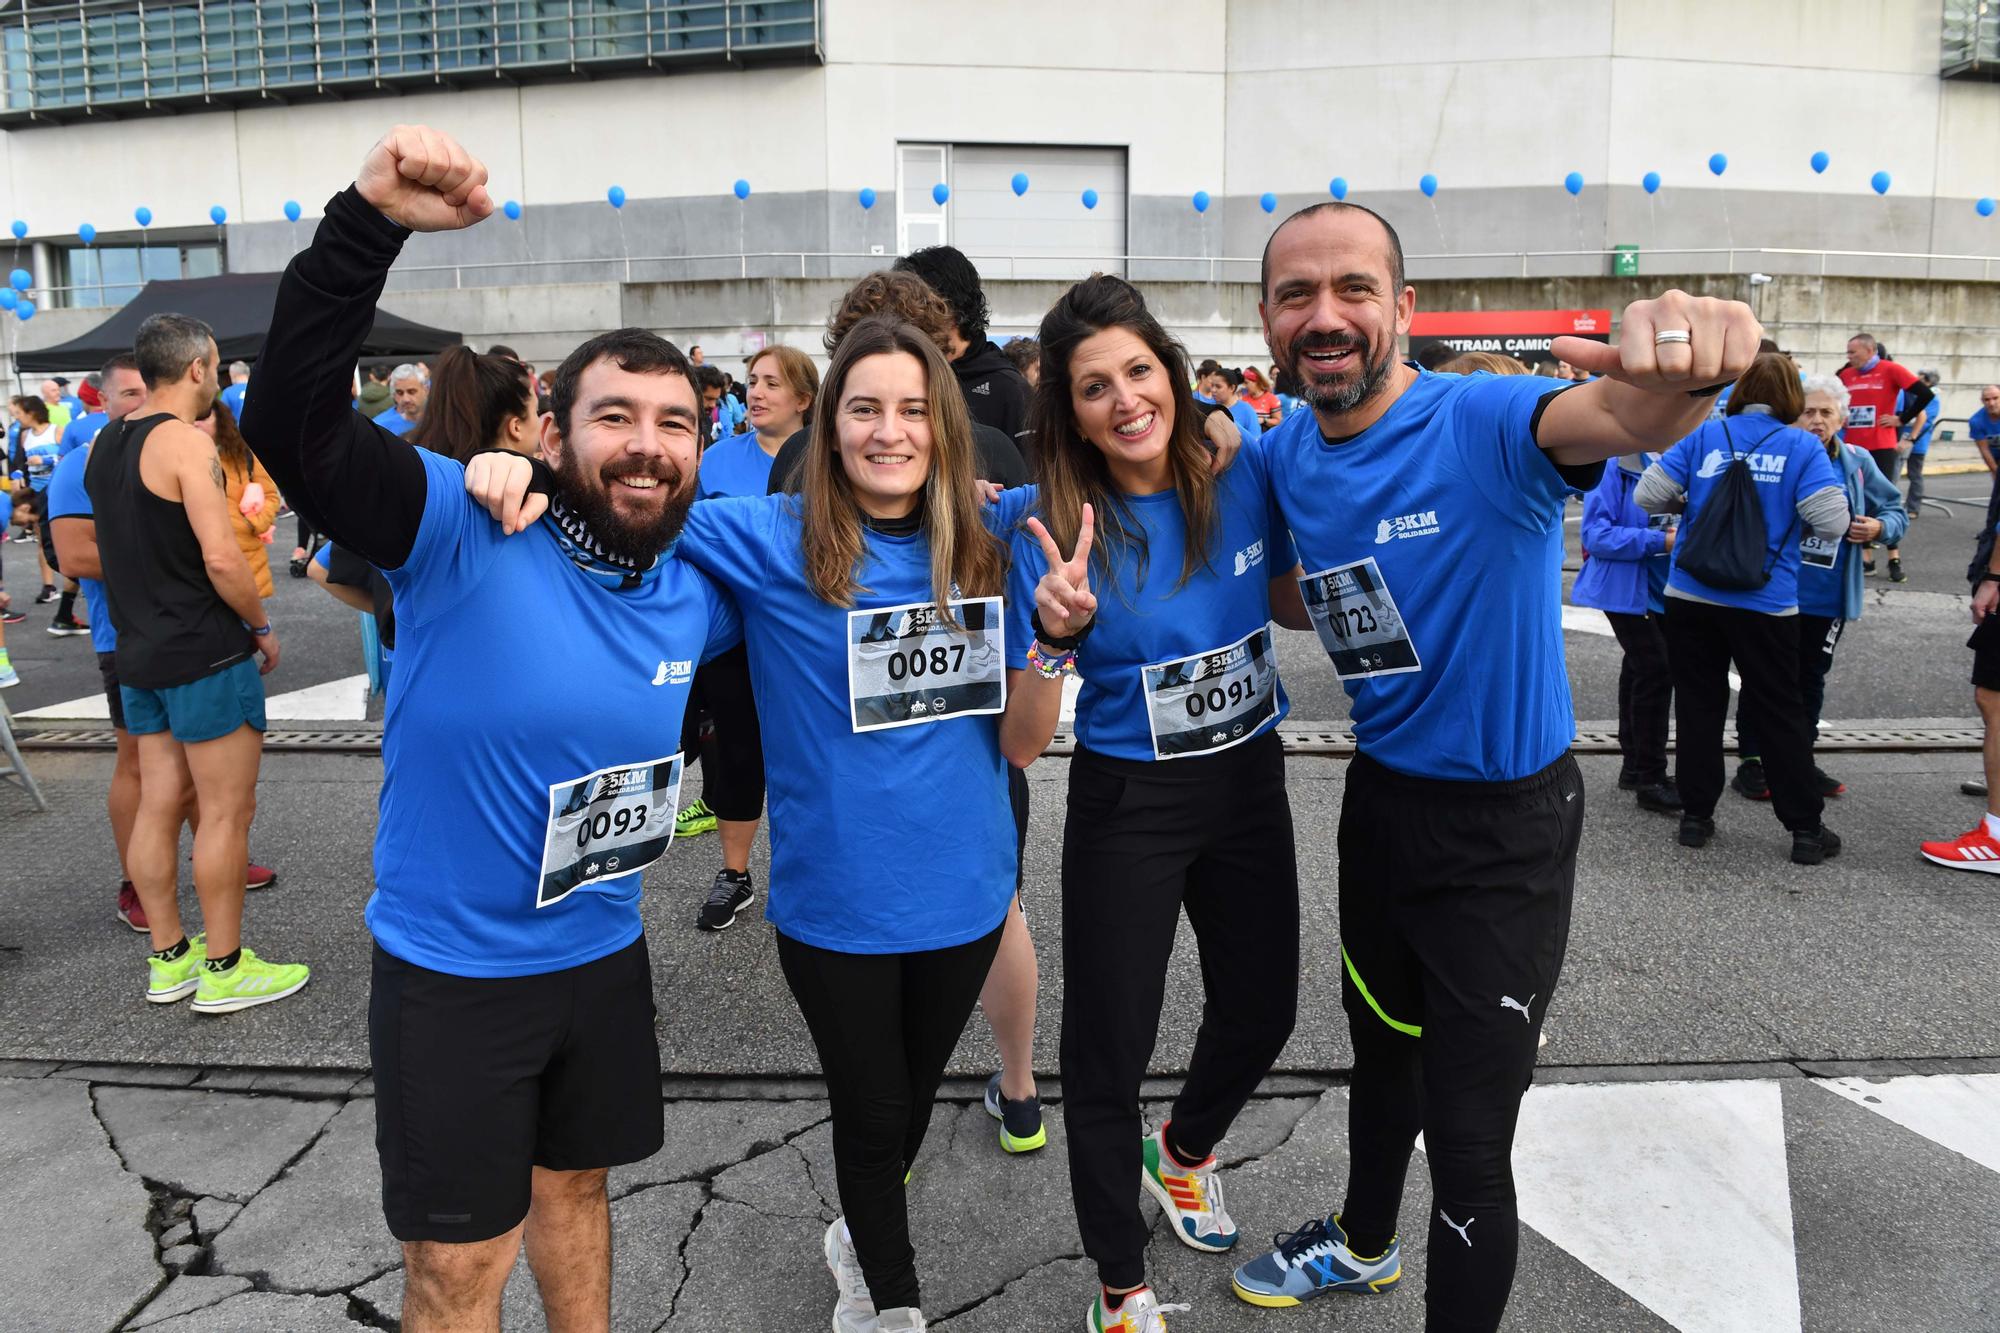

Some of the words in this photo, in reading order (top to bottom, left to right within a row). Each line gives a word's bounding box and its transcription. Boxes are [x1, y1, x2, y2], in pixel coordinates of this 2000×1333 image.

[1440, 339, 1502, 351] NTRADA
[1395, 510, 1438, 531] 5KM
[1398, 526, 1441, 540] SOLIDARIOS
[1328, 572, 1354, 590] 5KM
[1328, 605, 1378, 638] 0723
[888, 644, 966, 681] 0087
[1211, 645, 1246, 668] 5KM
[671, 660, 692, 675] 5KM
[1185, 674, 1256, 718] 0091
[609, 769, 648, 788] 5KM
[577, 804, 648, 848] 0093
